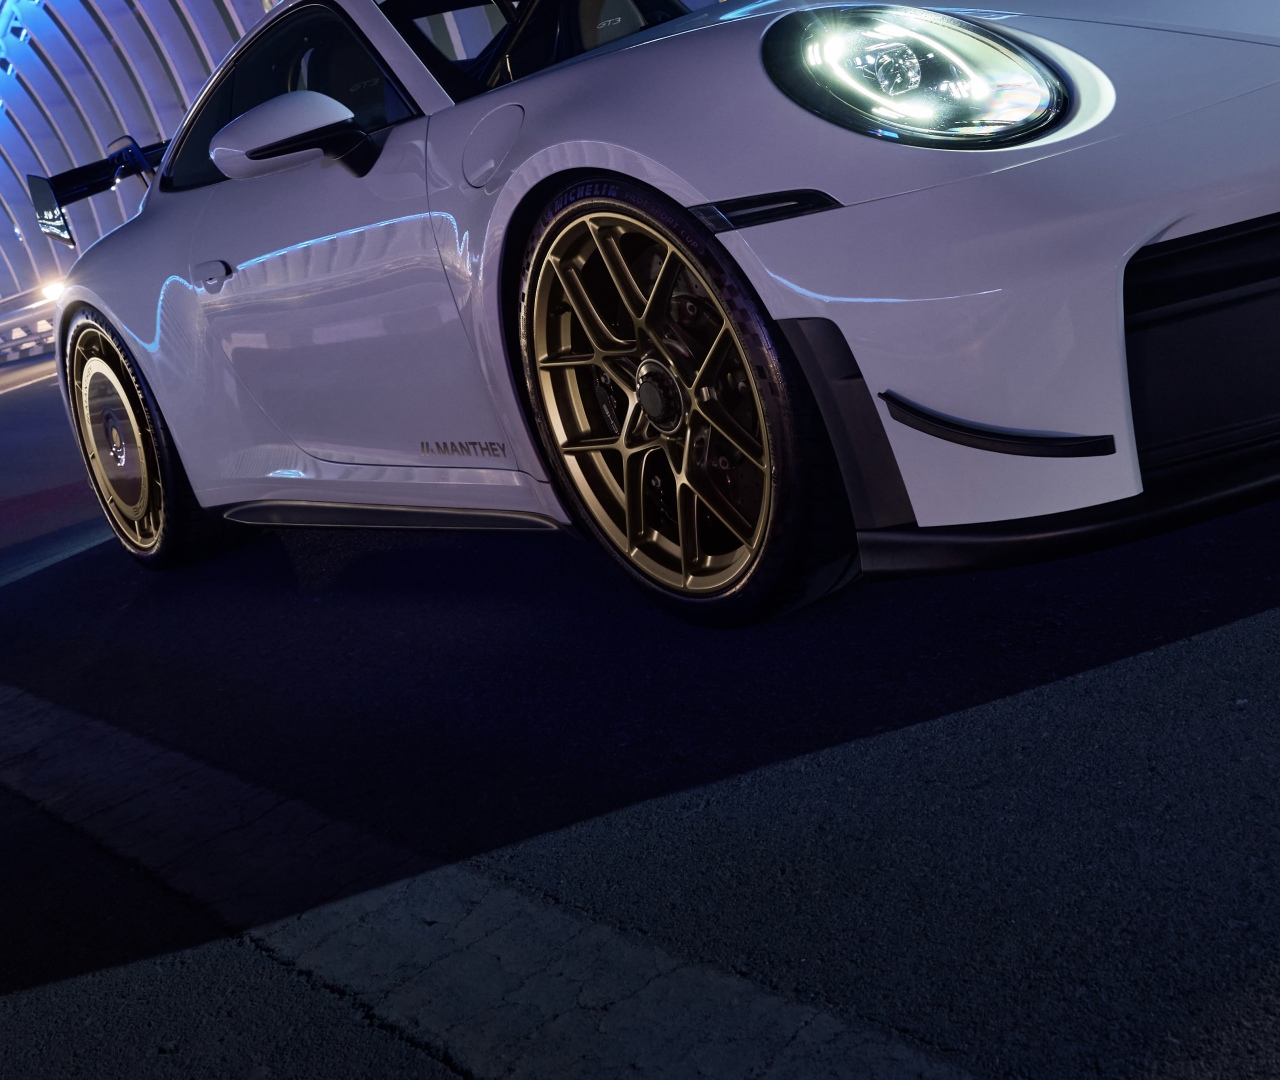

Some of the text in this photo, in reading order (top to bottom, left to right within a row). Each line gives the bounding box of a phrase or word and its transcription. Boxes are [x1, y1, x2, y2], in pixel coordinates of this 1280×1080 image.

[596, 16, 622, 29] GT3
[349, 77, 380, 92] GT3
[553, 183, 620, 213] MICHELIN
[624, 191, 650, 207] PILOT
[650, 202, 680, 229] SPORT
[680, 229, 699, 249] CUP
[435, 442, 507, 458] MANTHEY
